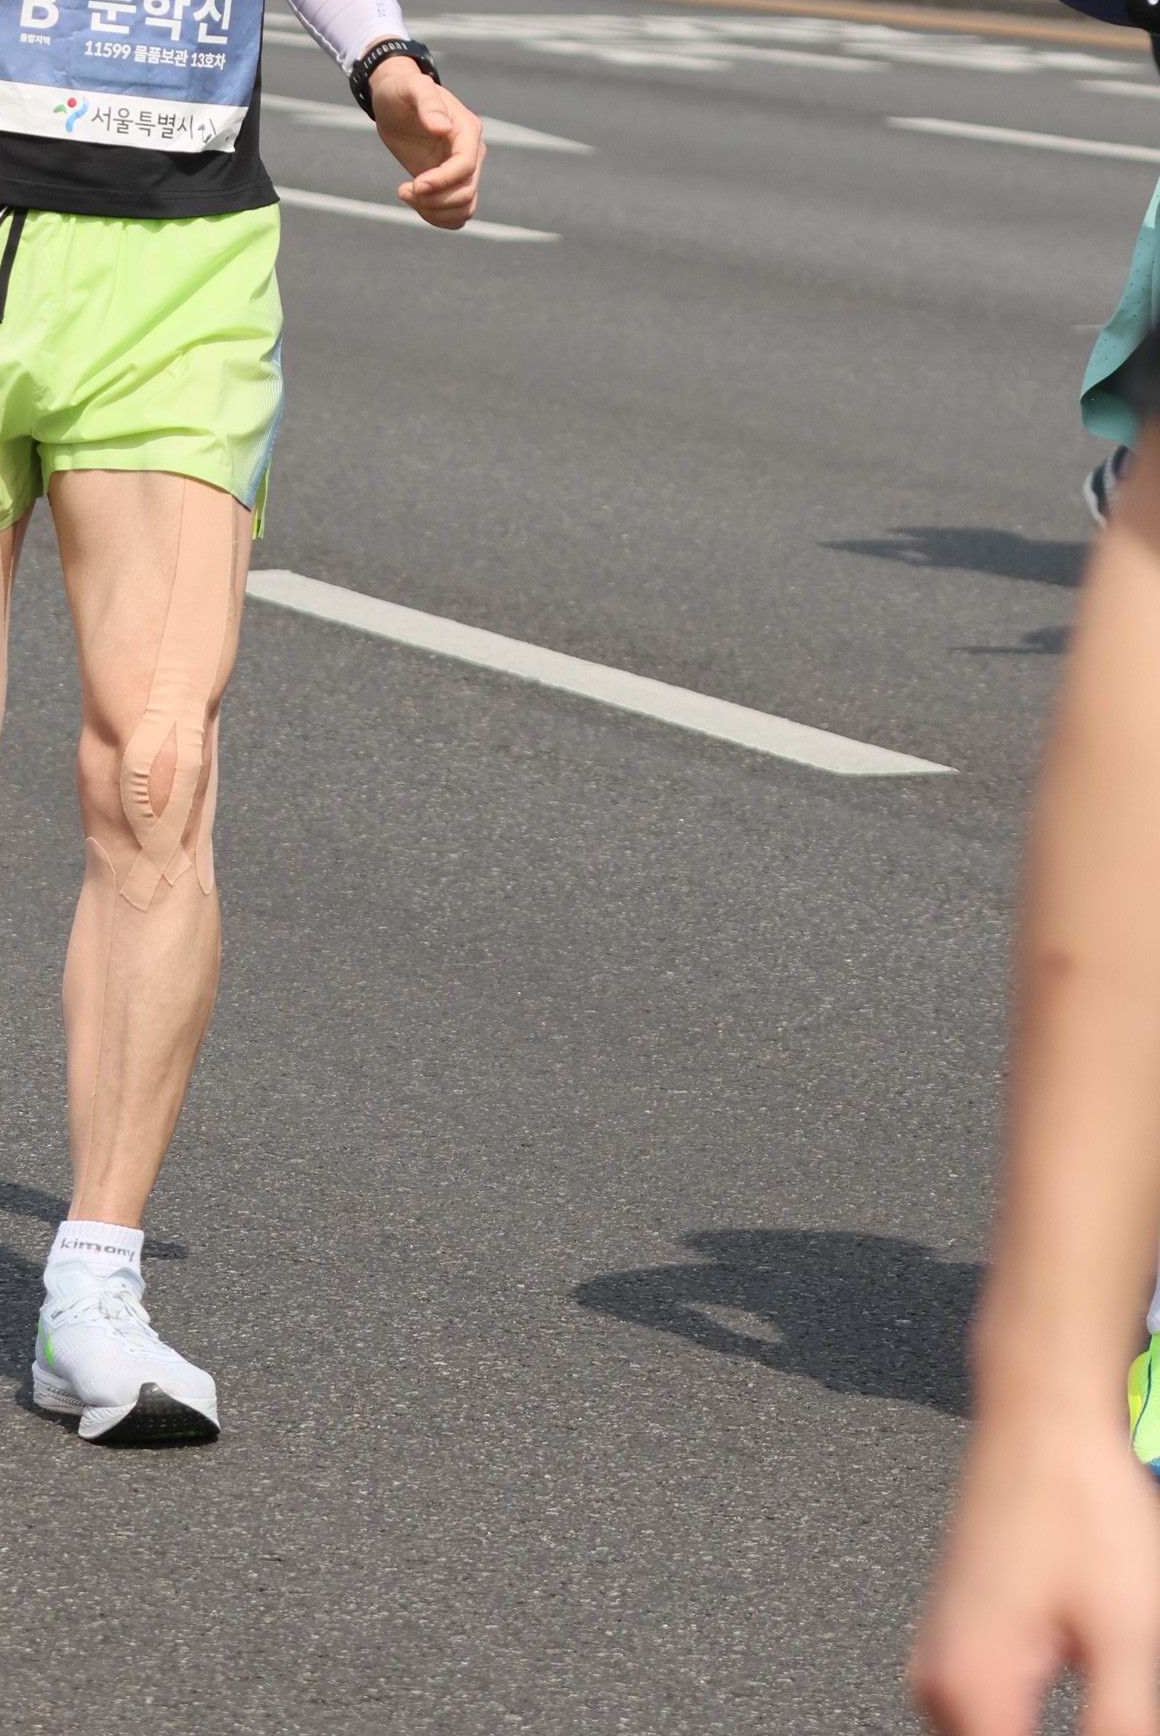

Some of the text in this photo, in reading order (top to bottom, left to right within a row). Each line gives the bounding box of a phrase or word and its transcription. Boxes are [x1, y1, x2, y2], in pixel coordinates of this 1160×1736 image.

[84, 40, 226, 70] 11599 물품보관 13호차
[91, 106, 194, 140] 서울특별시
[60, 1237, 136, 1262] kimony
